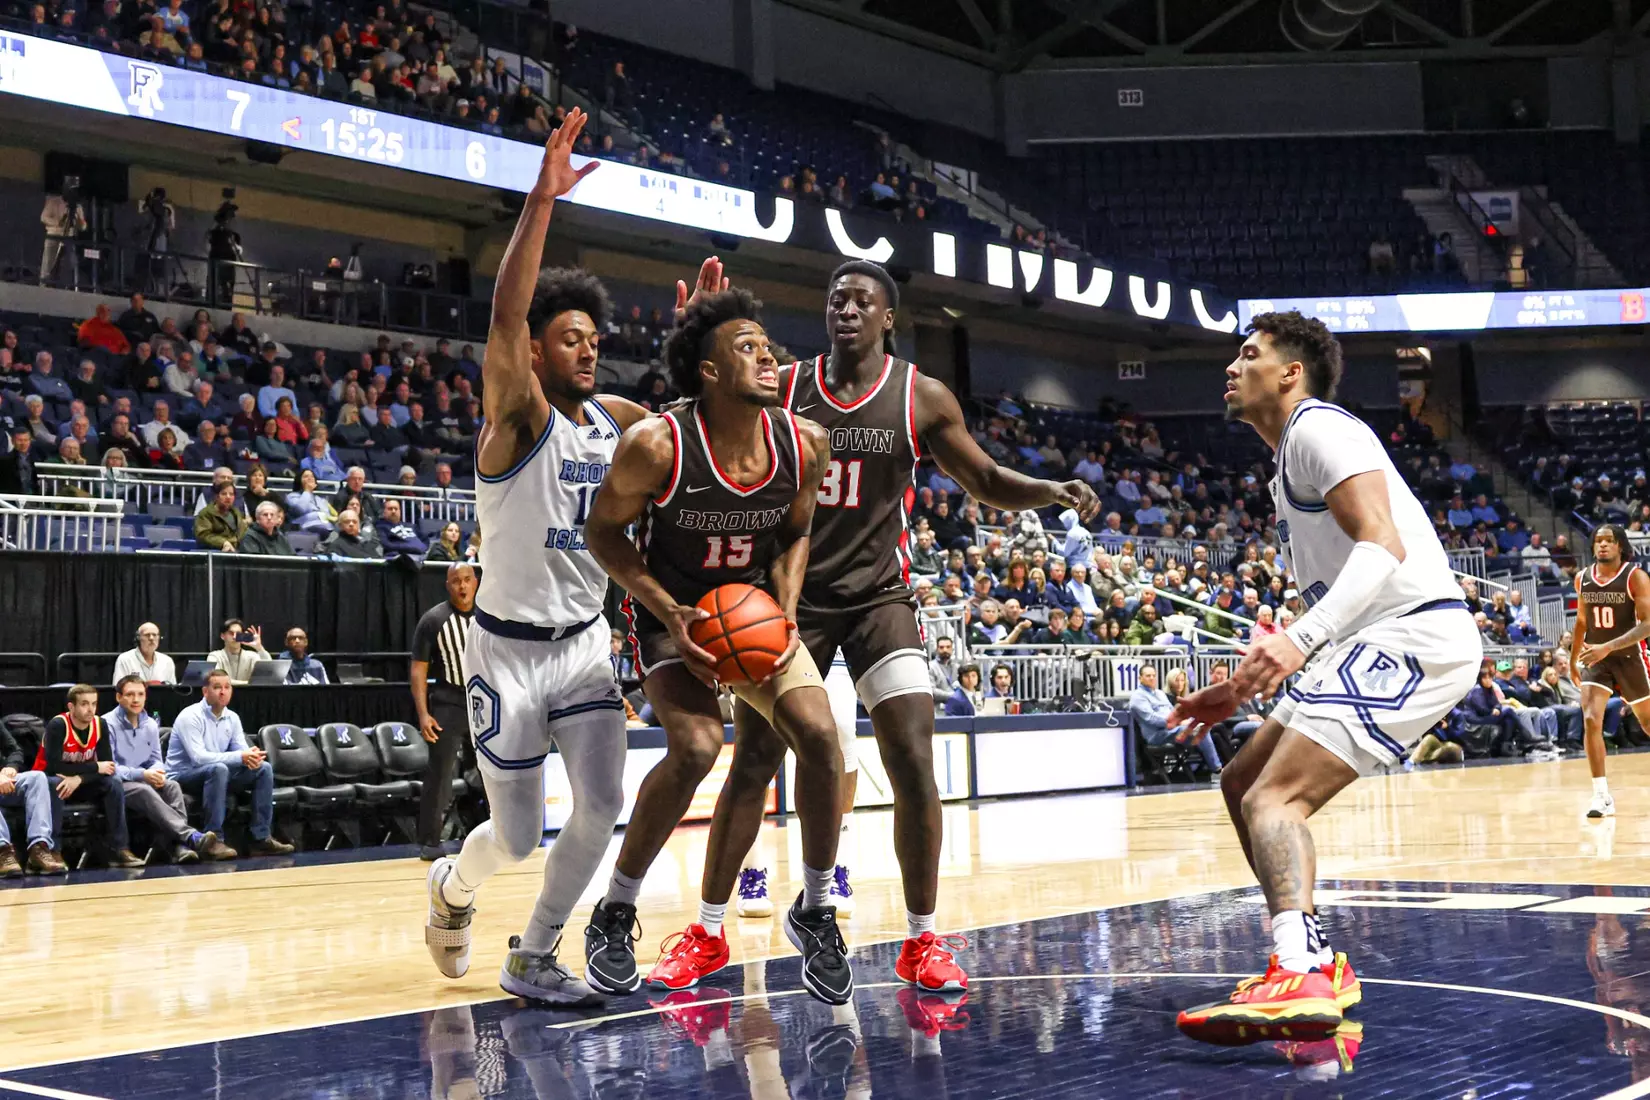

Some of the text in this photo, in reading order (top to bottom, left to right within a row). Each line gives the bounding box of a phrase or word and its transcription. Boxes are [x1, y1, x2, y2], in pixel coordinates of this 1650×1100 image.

[226, 89, 251, 131] 7
[1120, 91, 1141, 104] 313
[349, 108, 377, 128] 1ST
[320, 118, 404, 164] 15:25
[465, 141, 487, 179] 6
[1121, 363, 1142, 377] 214
[825, 427, 895, 453] OWN
[816, 458, 863, 508] 31
[676, 503, 790, 531] BROWN
[702, 535, 755, 568] 15
[1582, 592, 1625, 604] BROWN
[1593, 606, 1614, 628] 10
[1117, 663, 1139, 691] 111
